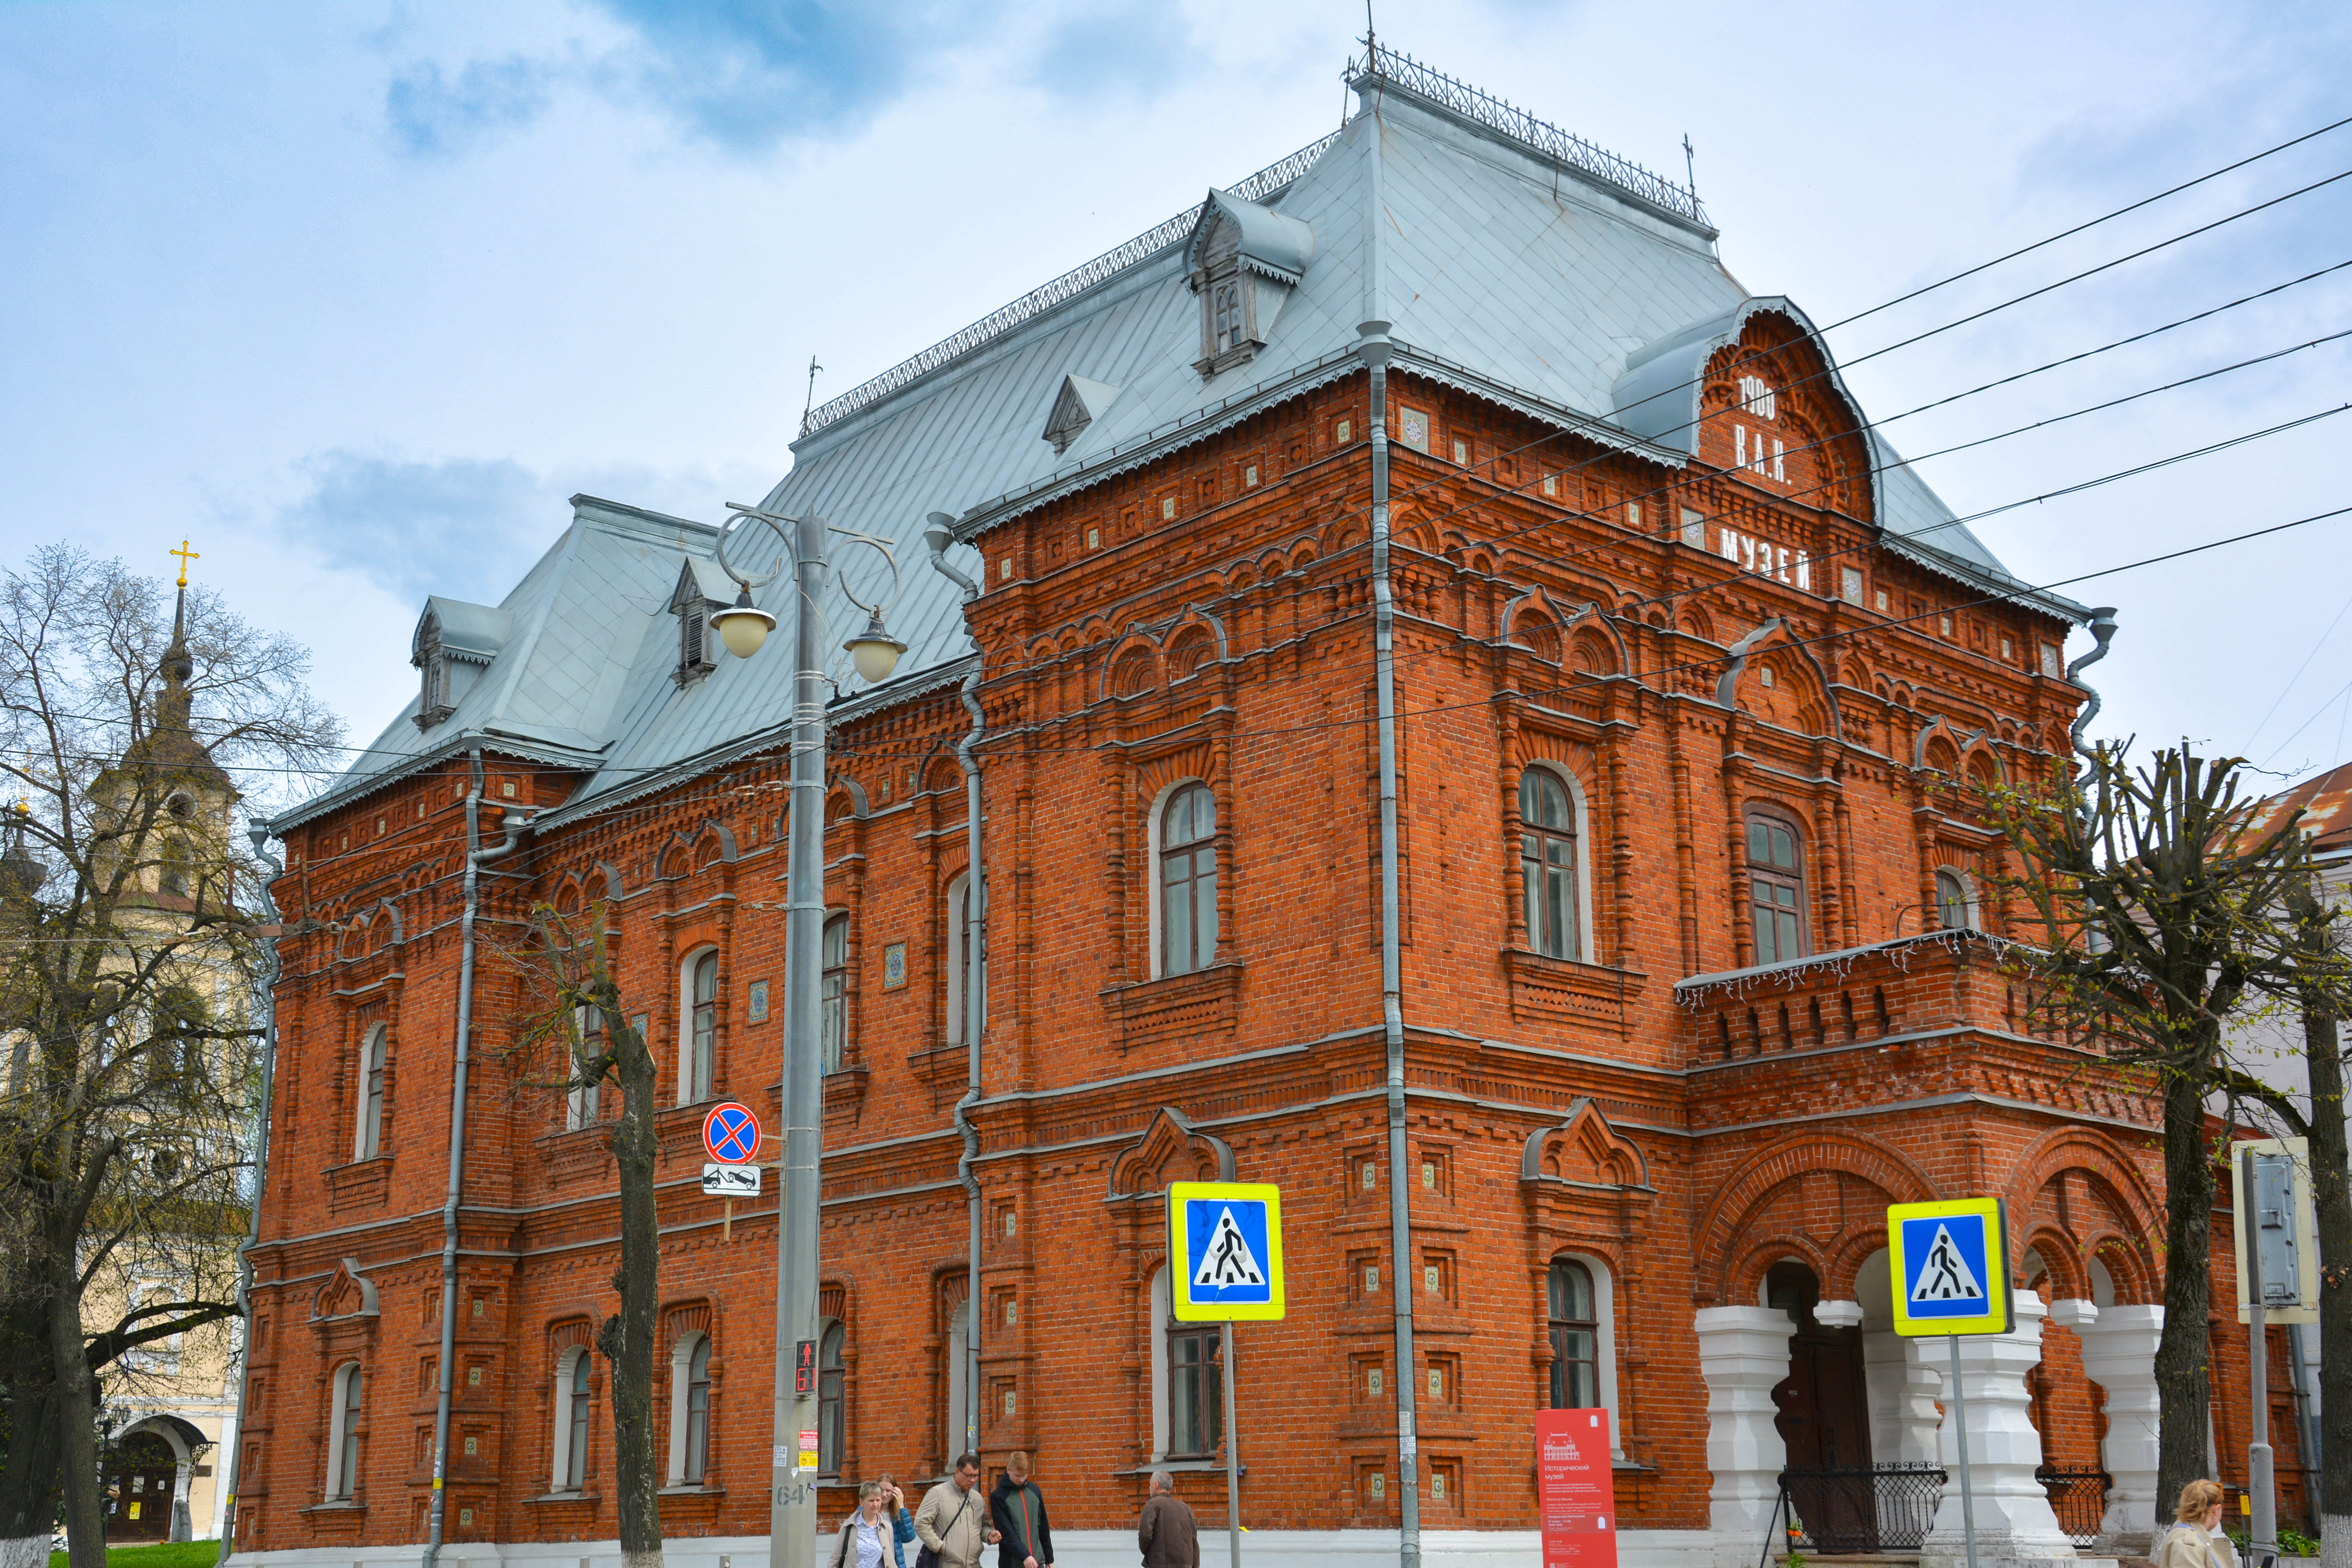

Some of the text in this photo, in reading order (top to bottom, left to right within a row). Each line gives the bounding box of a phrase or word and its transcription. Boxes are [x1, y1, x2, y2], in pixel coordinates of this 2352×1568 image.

[1737, 374, 1775, 421] 1900
[1719, 528, 1810, 591] МУЗЕЙ
[797, 1368, 816, 1391] 61
[777, 1484, 805, 1506] 64
